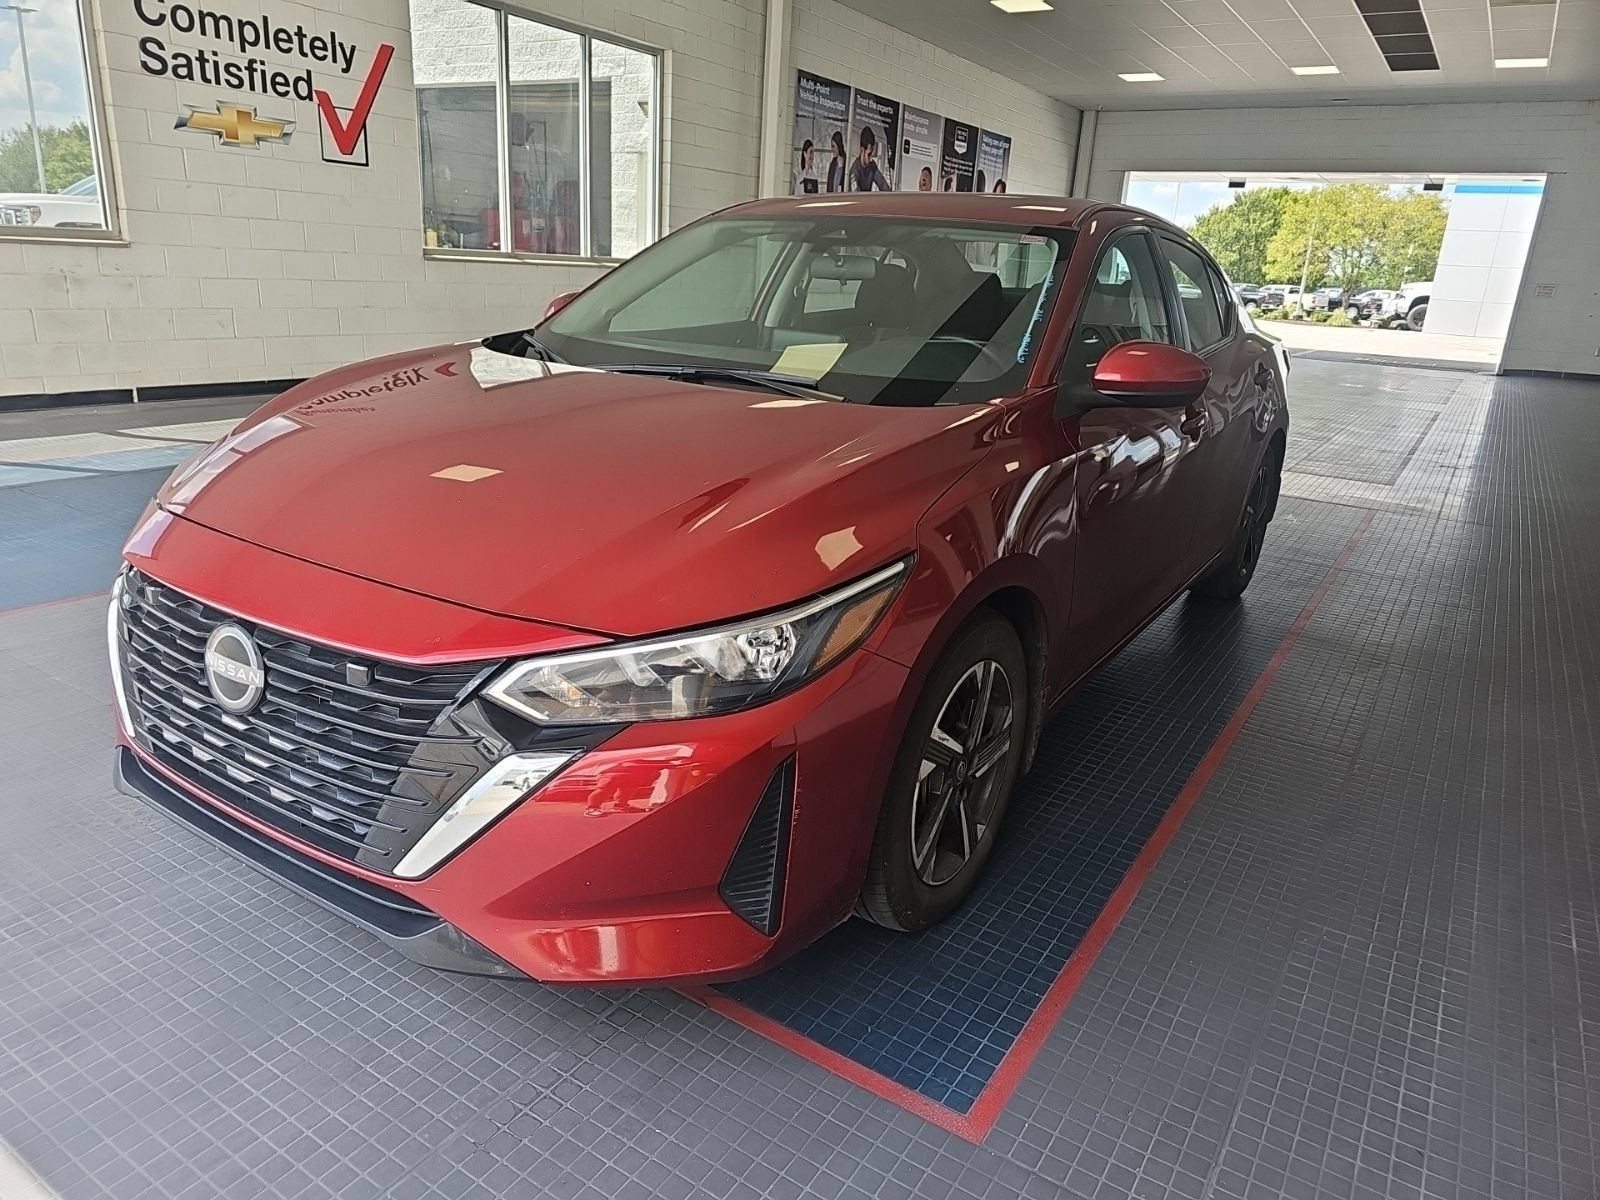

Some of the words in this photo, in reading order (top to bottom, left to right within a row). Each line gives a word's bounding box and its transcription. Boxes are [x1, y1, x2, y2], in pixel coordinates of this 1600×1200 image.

[133, 0, 356, 73] Completely
[139, 36, 314, 102] Satisfied
[800, 88, 819, 104] Vehicle
[819, 96, 846, 111] Inspection
[856, 94, 869, 107] Trust
[207, 652, 260, 684] NISSAN
